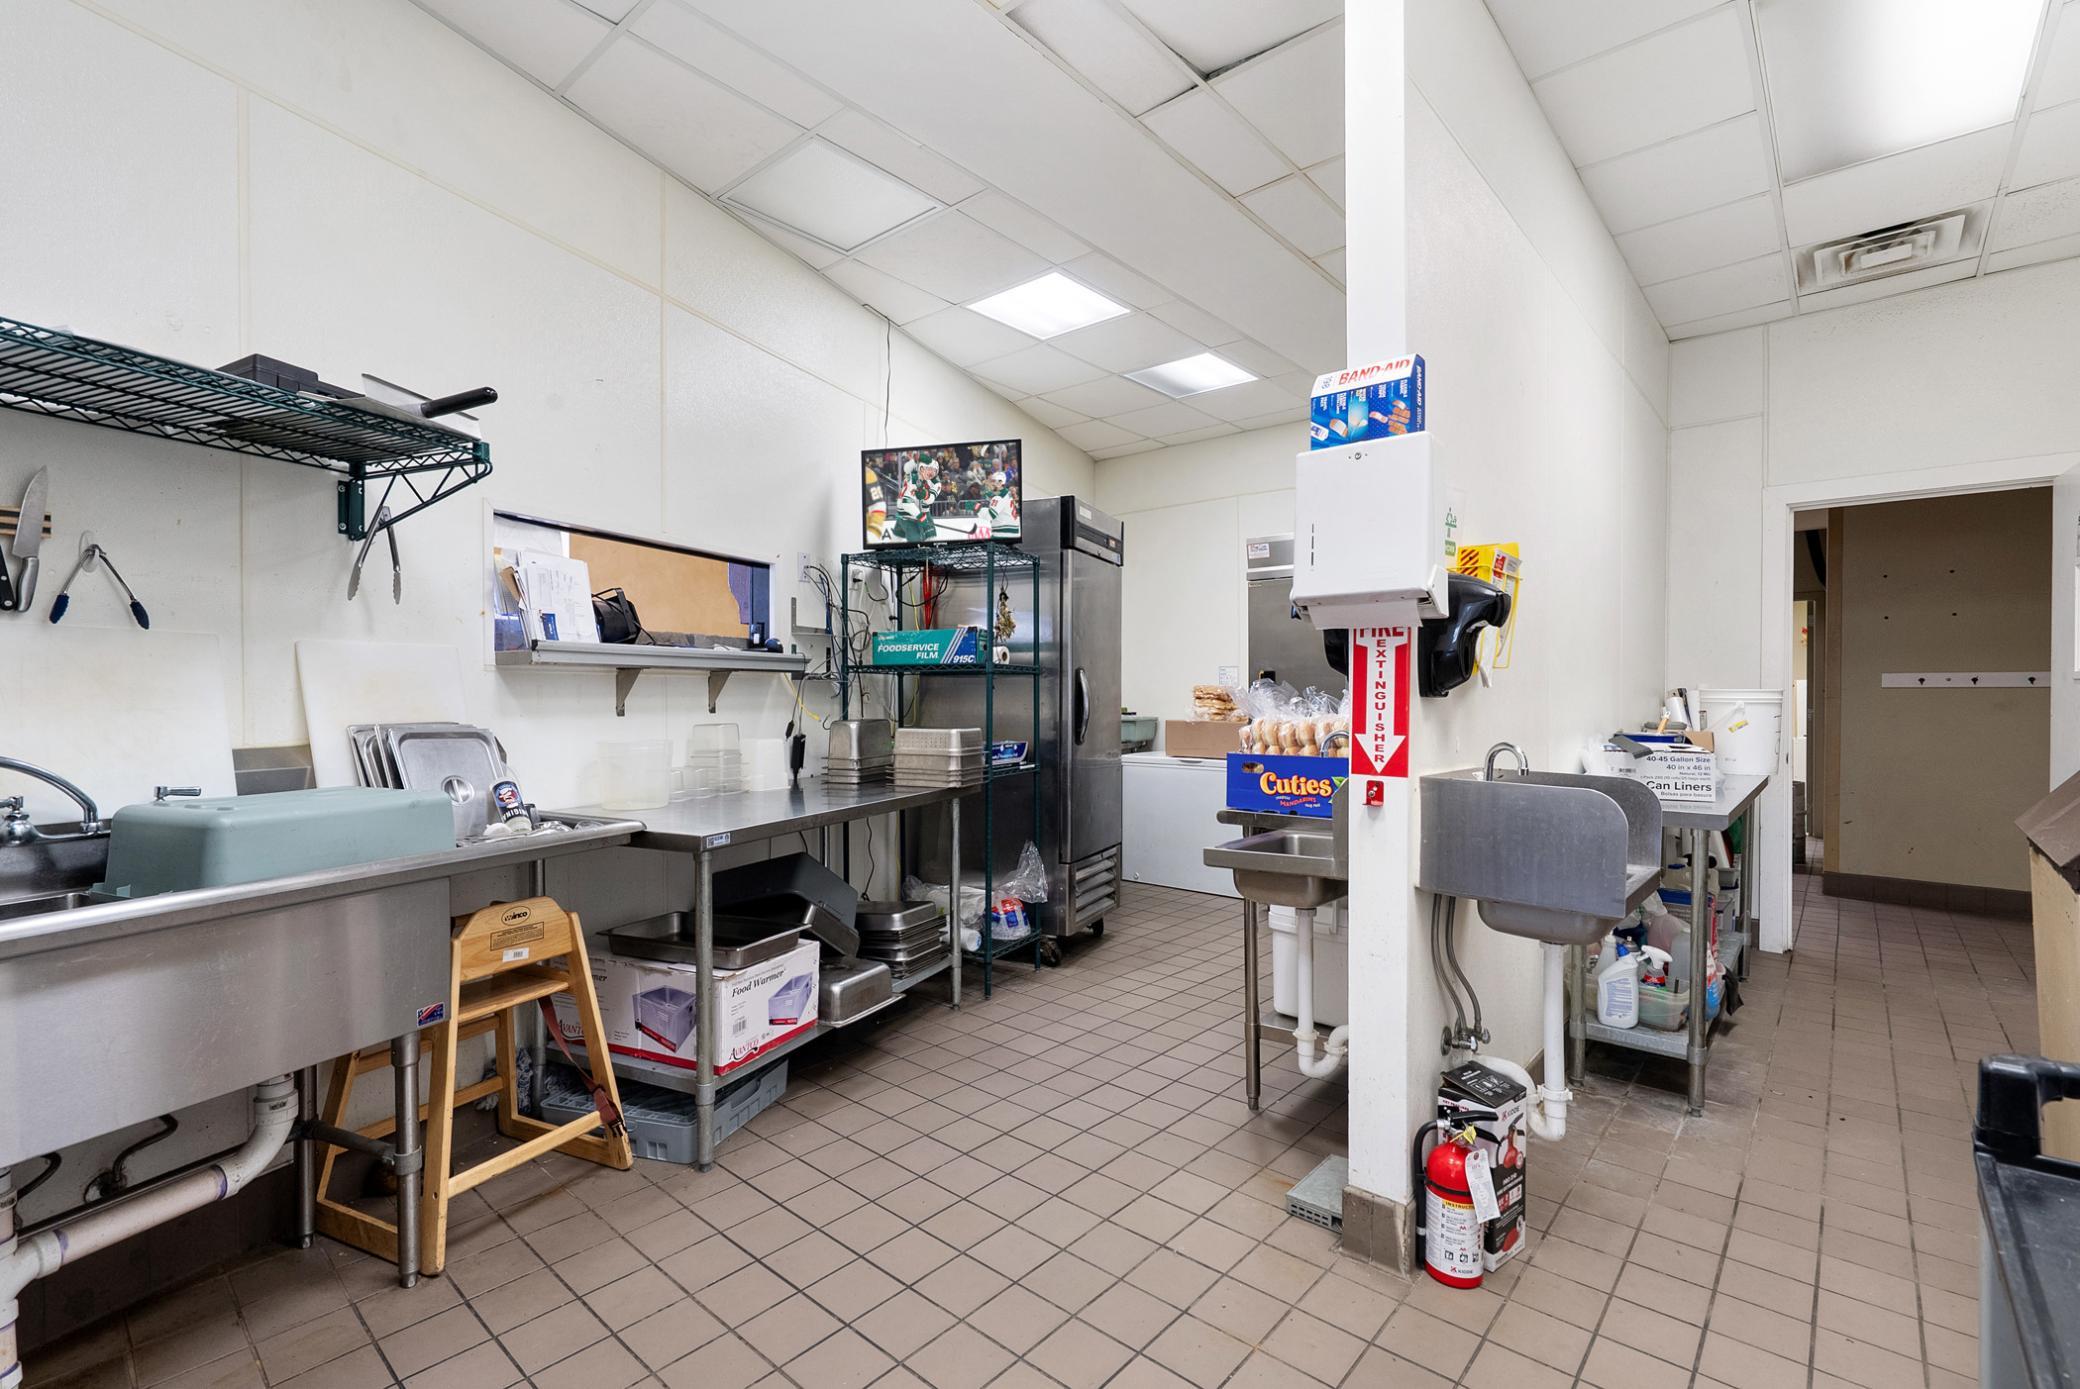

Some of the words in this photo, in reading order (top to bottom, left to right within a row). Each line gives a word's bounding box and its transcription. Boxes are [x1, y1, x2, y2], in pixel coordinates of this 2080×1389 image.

[1338, 359, 1411, 385] BAND-AID
[877, 643, 940, 652] FOODSERVICE
[916, 651, 938, 659] FILM
[953, 655, 975, 663] 915C
[1374, 639, 1386, 763] EXTINGUISHER
[1260, 771, 1333, 797] Cuties
[1646, 780, 1670, 790] Can
[1674, 781, 1712, 791] Liners
[732, 981, 752, 997] Food
[753, 970, 784, 988] Warmer
